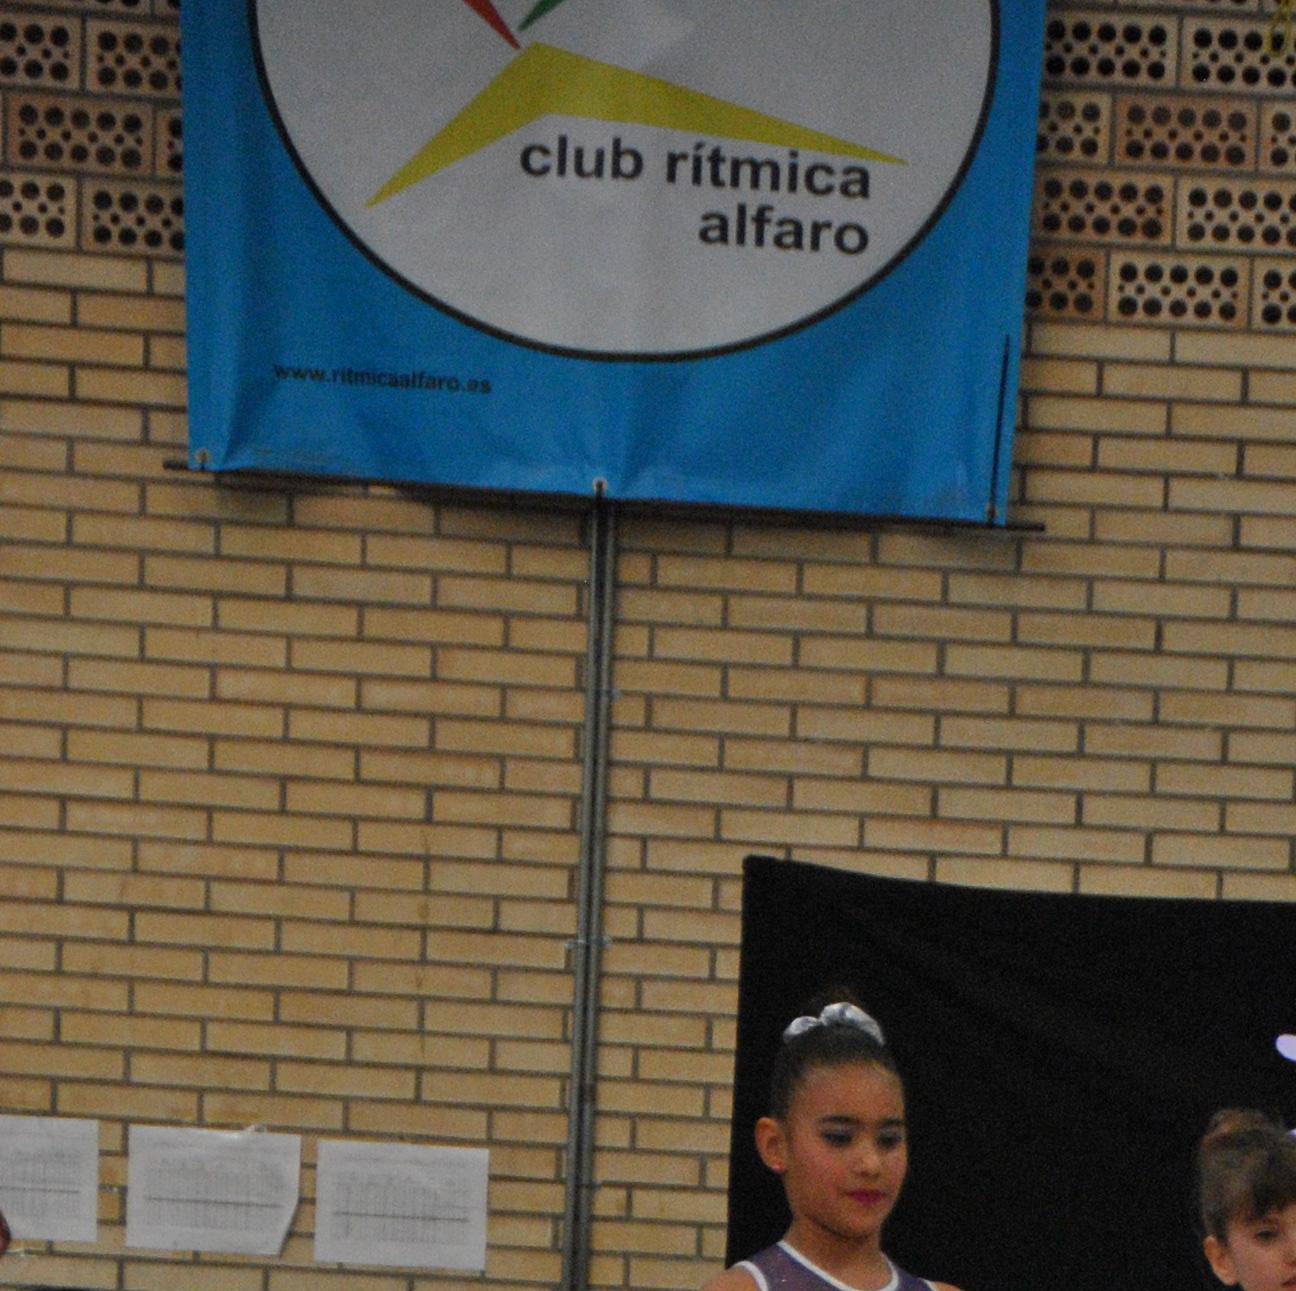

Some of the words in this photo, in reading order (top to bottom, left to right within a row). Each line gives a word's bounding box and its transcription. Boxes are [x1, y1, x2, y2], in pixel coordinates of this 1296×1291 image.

[519, 133, 645, 180] club
[665, 141, 871, 200] rítmica
[699, 202, 870, 256] alfaro
